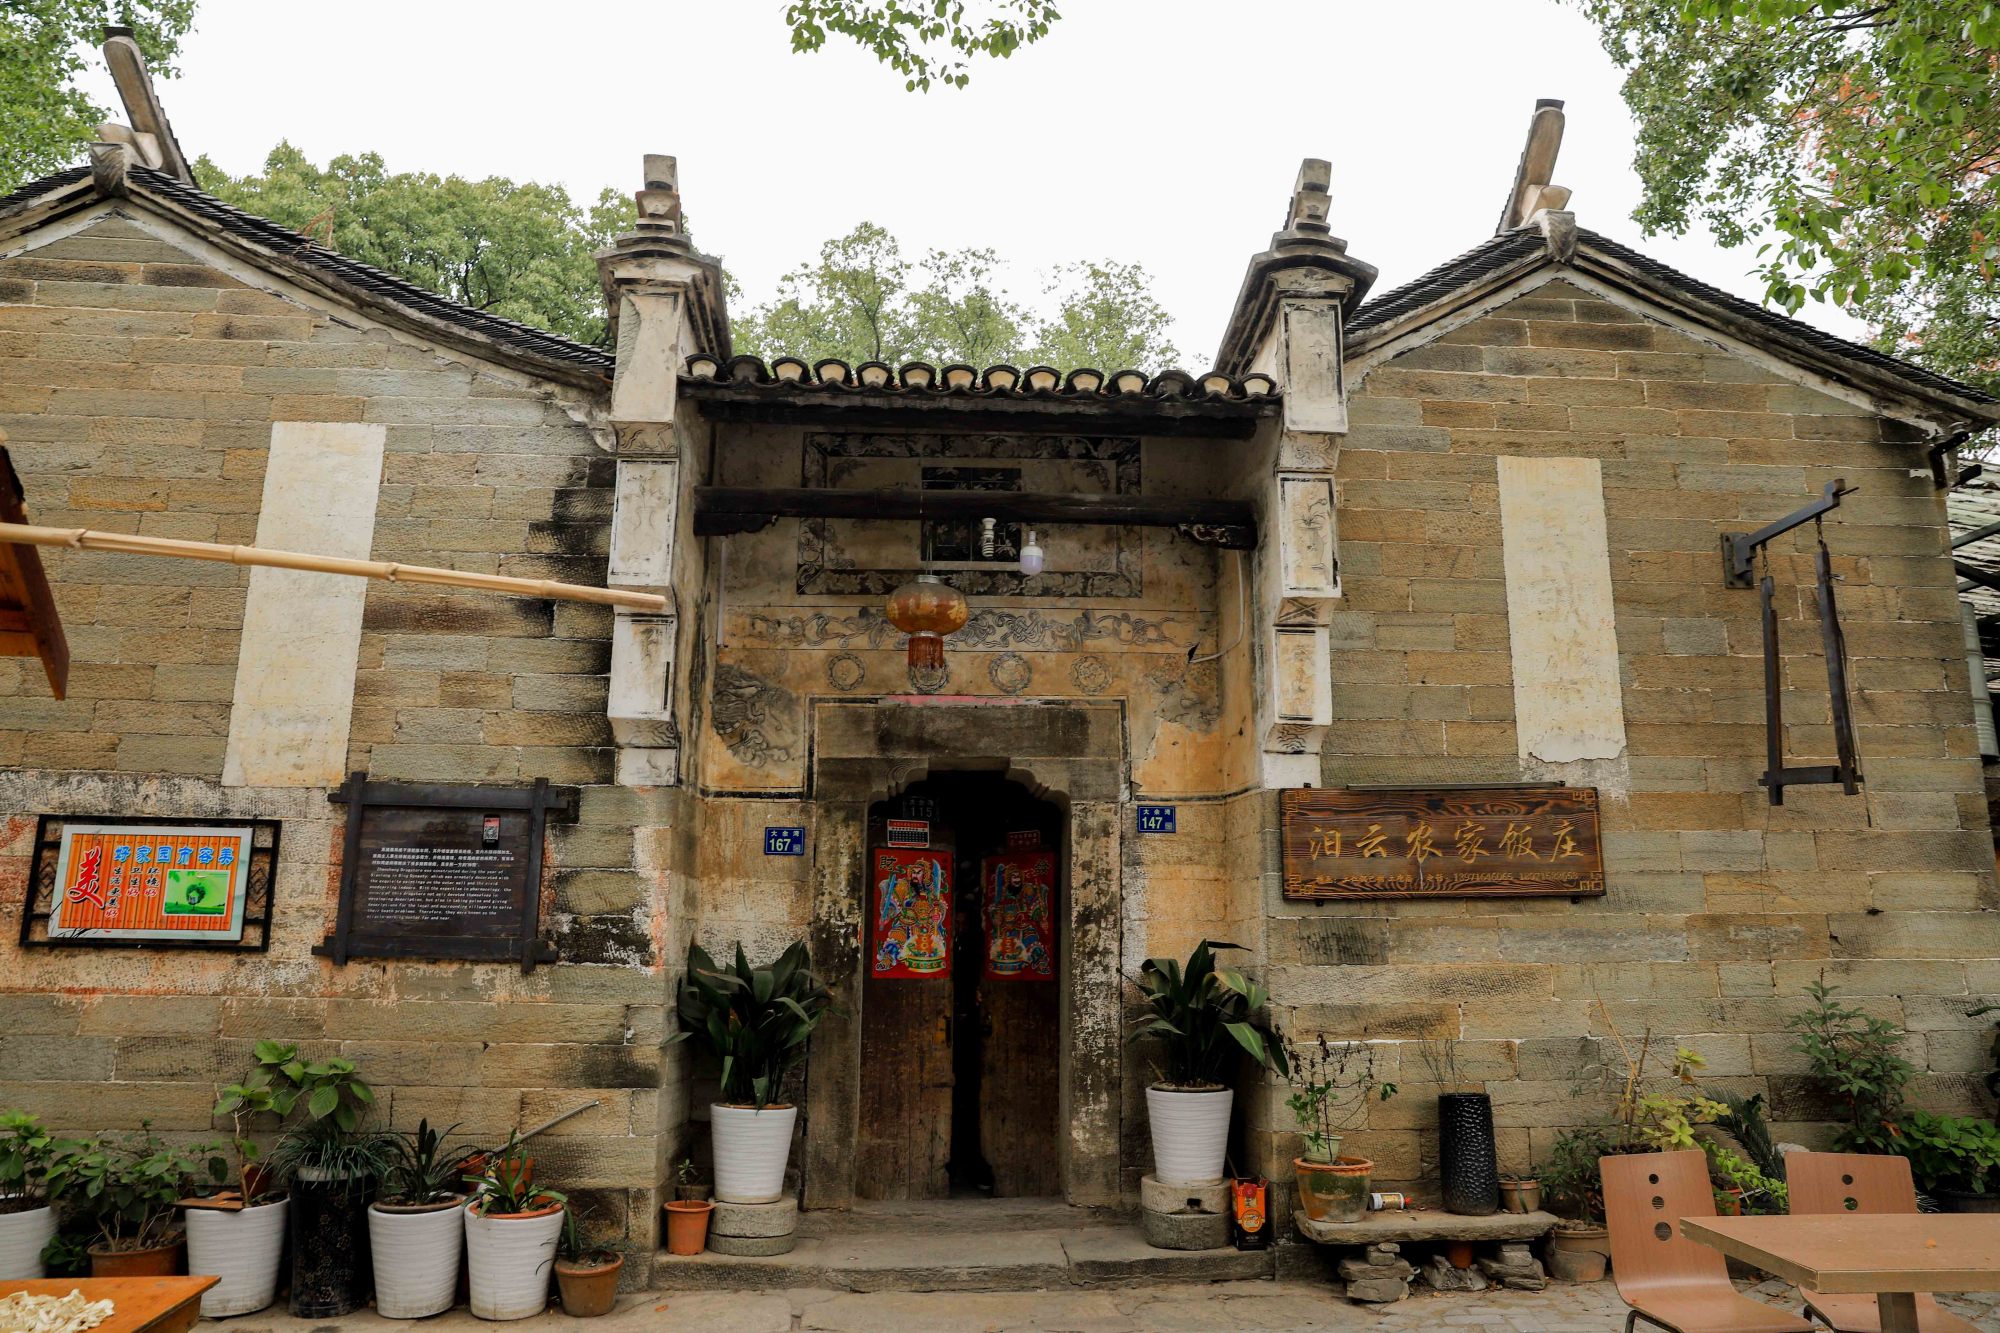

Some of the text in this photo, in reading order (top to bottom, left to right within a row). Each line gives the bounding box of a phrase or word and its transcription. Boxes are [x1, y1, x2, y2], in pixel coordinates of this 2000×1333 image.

[1141, 816, 1163, 830] 147
[769, 838, 791, 851] 167
[67, 845, 105, 910] 美
